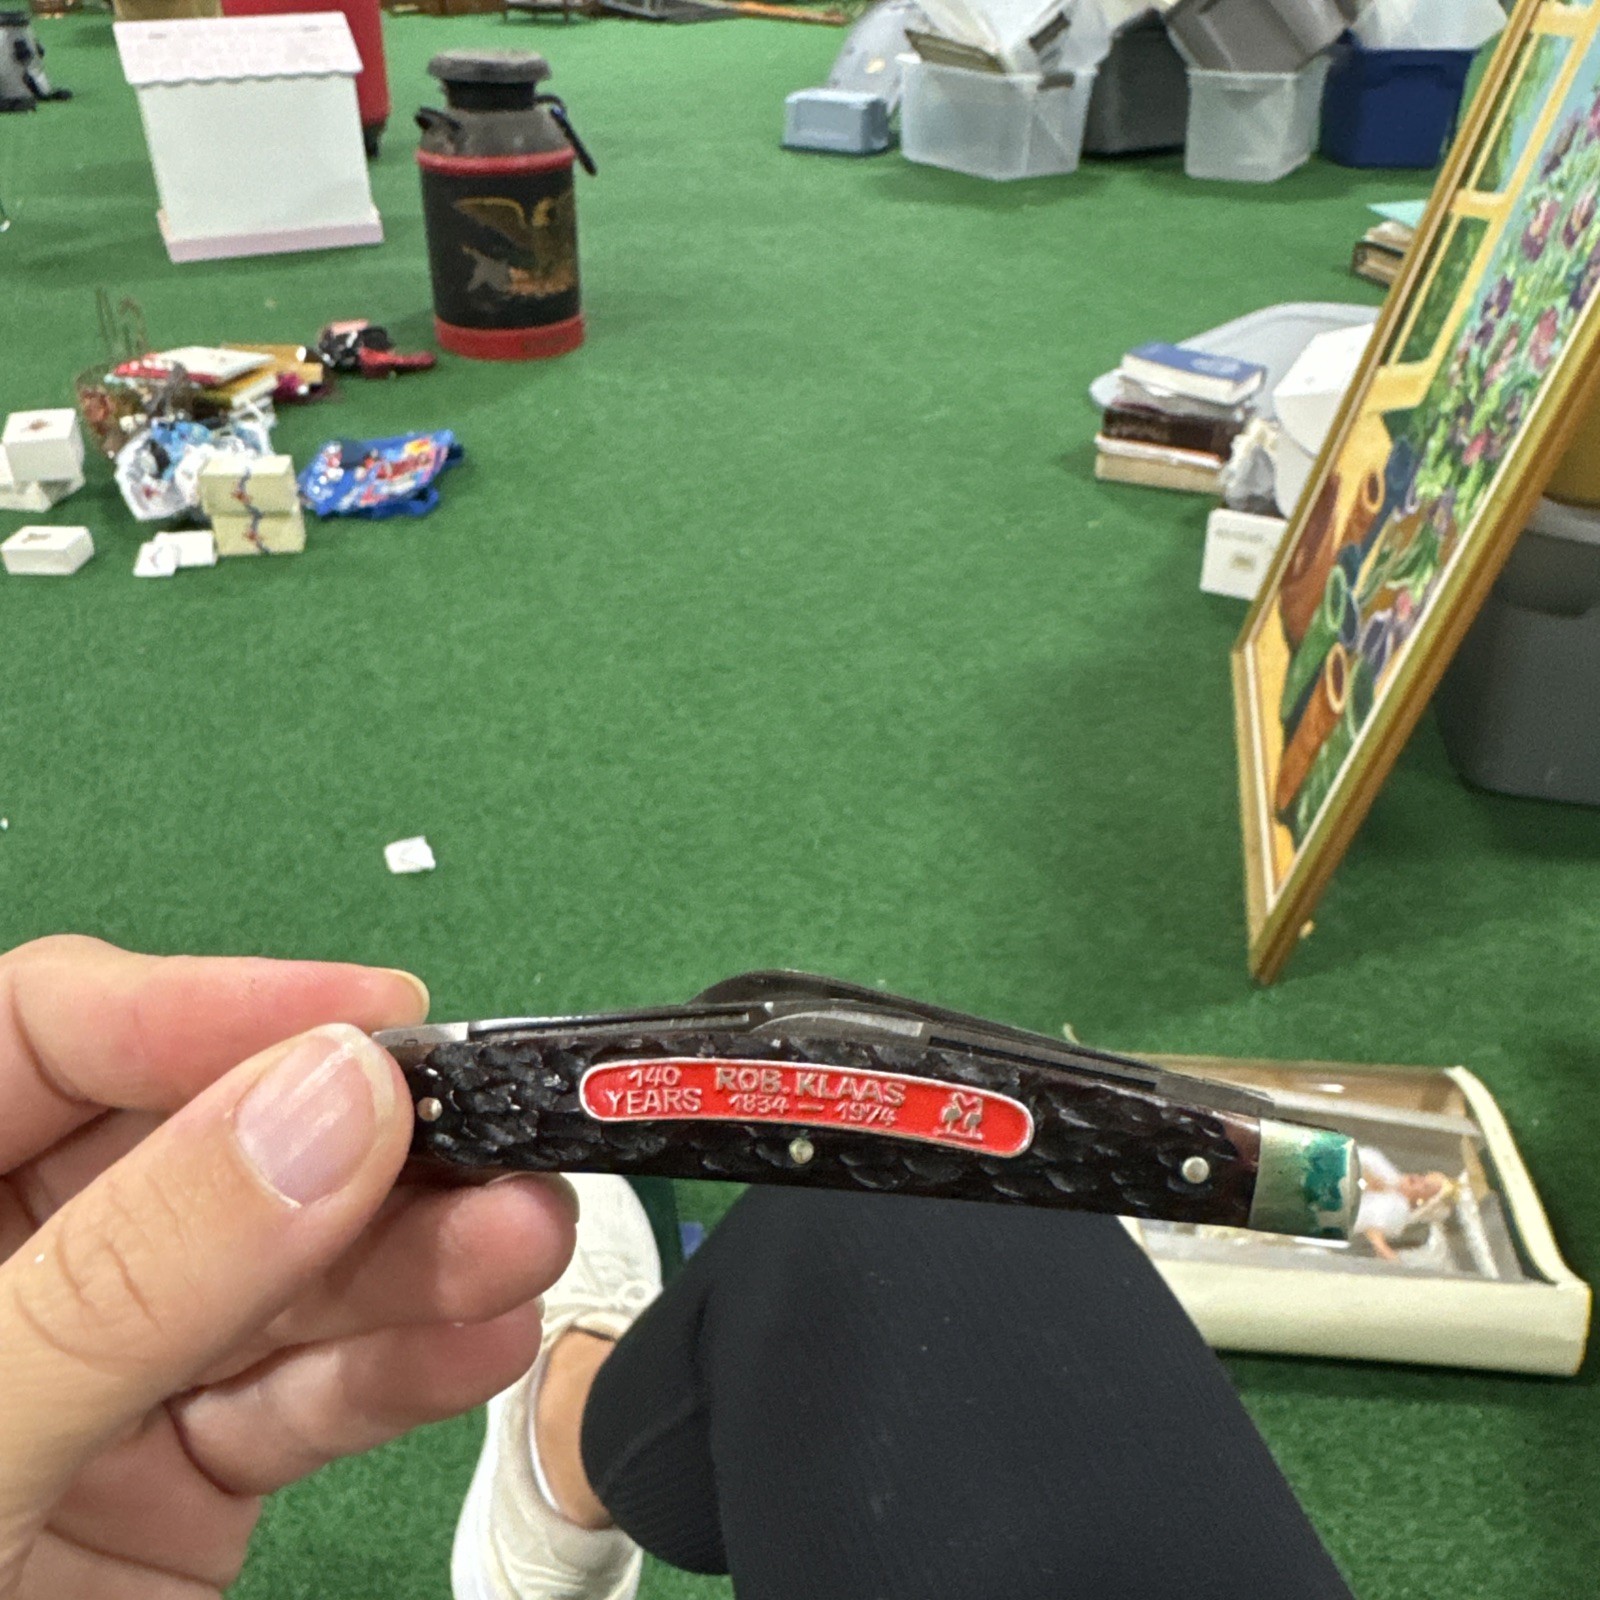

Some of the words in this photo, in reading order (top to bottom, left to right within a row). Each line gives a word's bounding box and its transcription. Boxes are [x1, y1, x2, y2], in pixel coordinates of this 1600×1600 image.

[628, 1066, 682, 1087] 140
[715, 1066, 791, 1094] ROB.
[796, 1070, 906, 1107] KLAAS
[605, 1087, 702, 1114] YEARS
[729, 1093, 790, 1114] 1834
[836, 1101, 897, 1126] 1974
